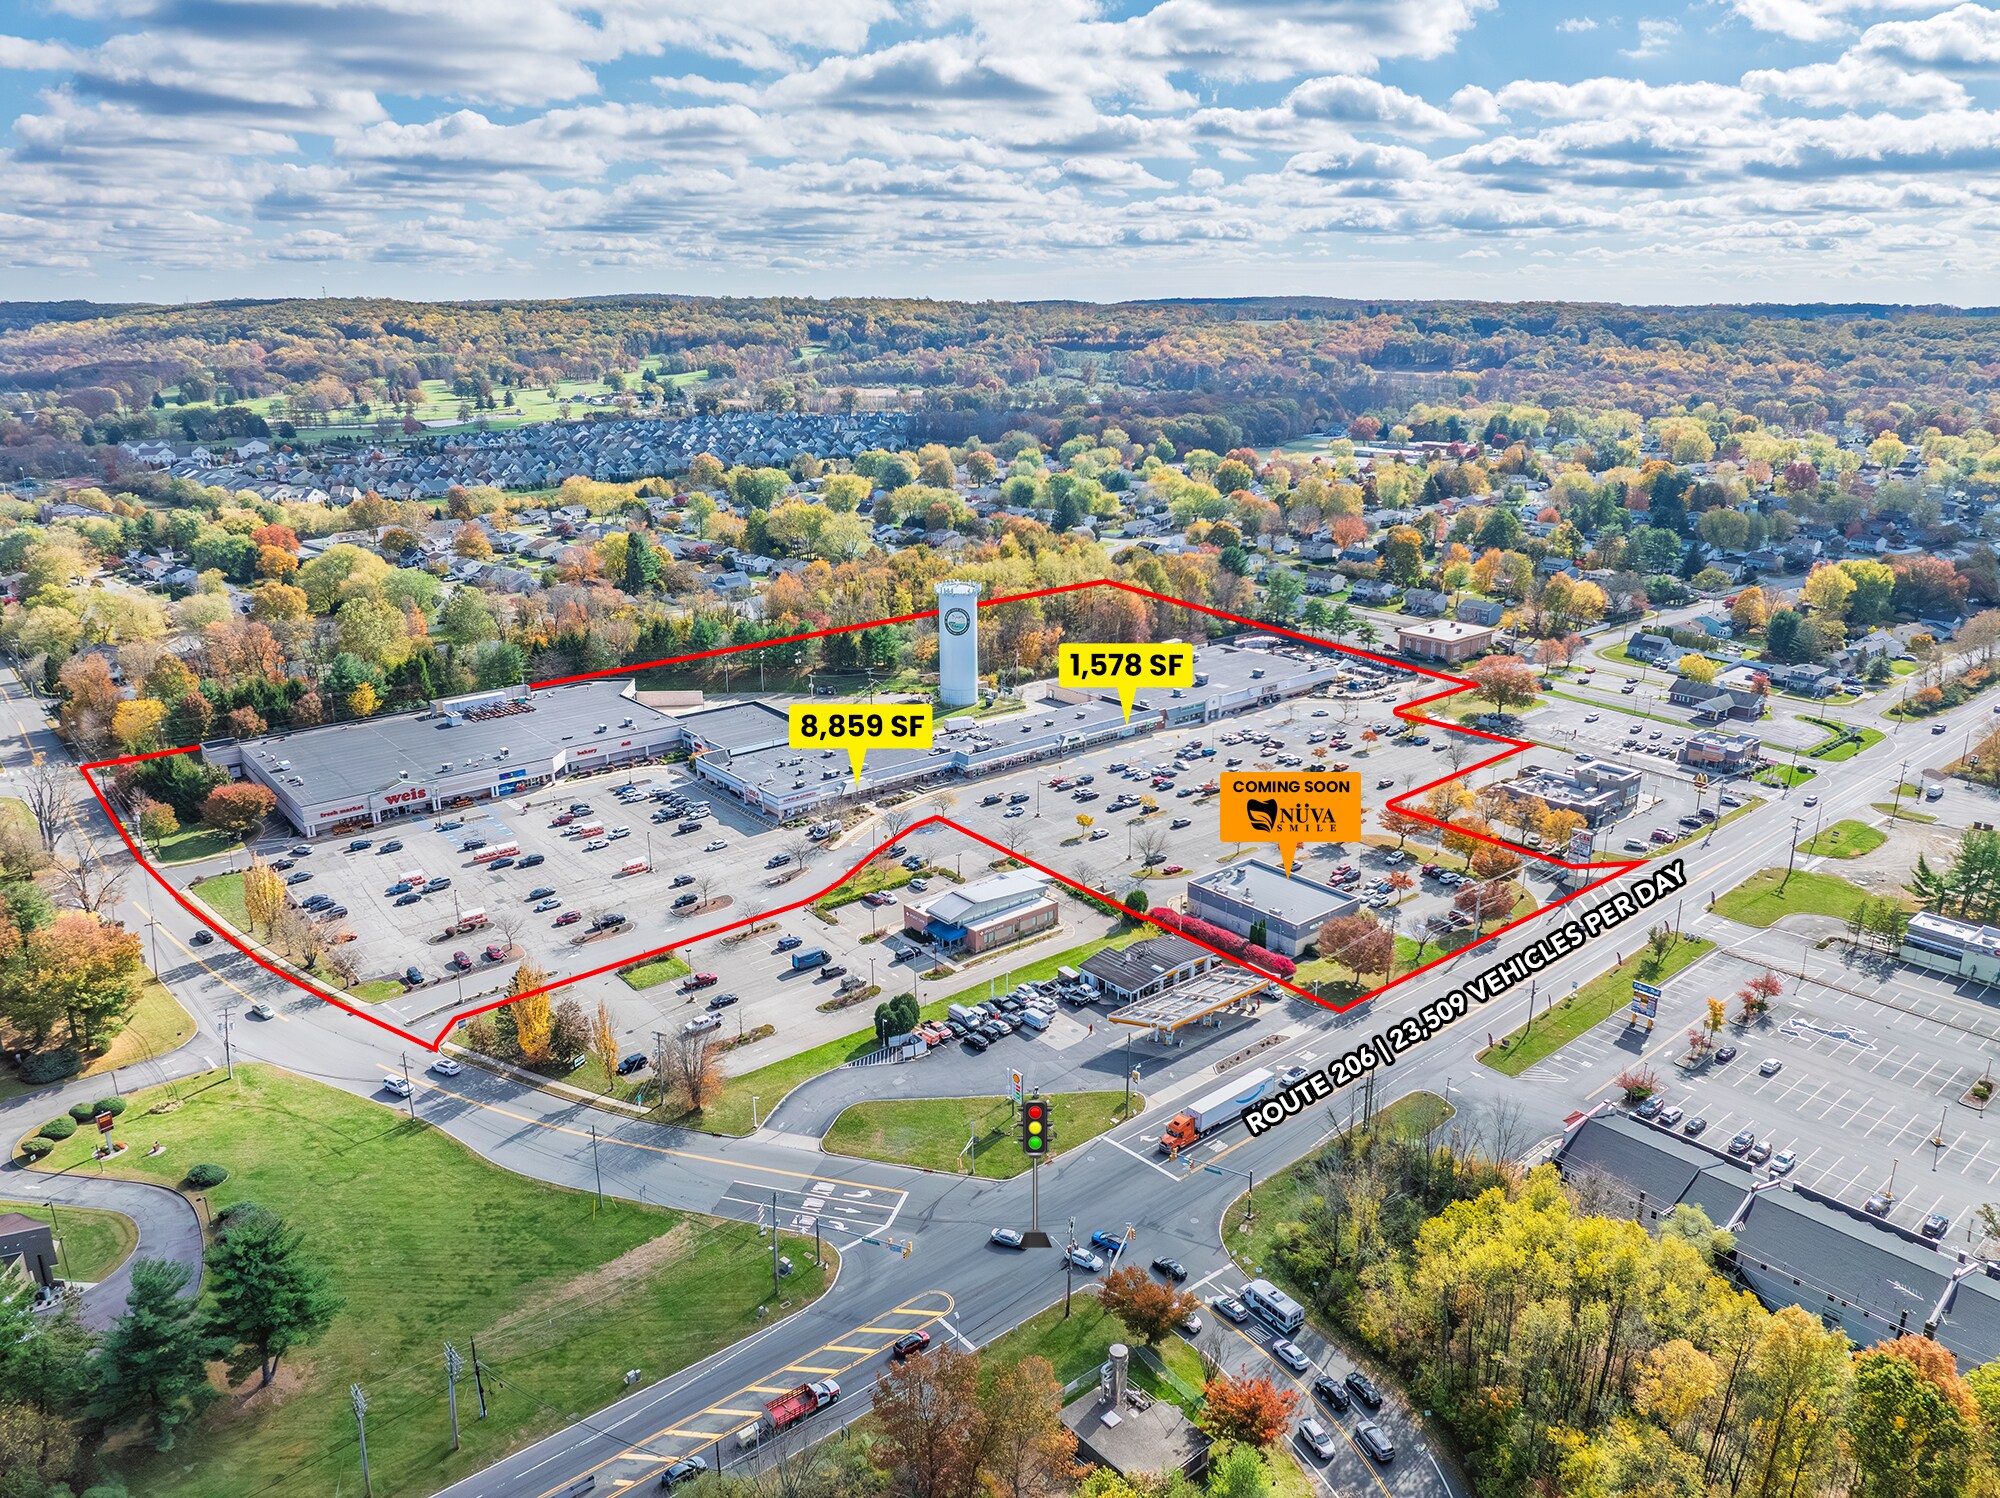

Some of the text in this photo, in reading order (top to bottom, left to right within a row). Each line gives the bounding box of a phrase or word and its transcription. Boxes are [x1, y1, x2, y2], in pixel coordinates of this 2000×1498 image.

[577, 748, 597, 756] bakery
[384, 788, 427, 805] weis
[320, 804, 364, 818] fresh market
[1244, 1323, 1274, 1344] ONLY
